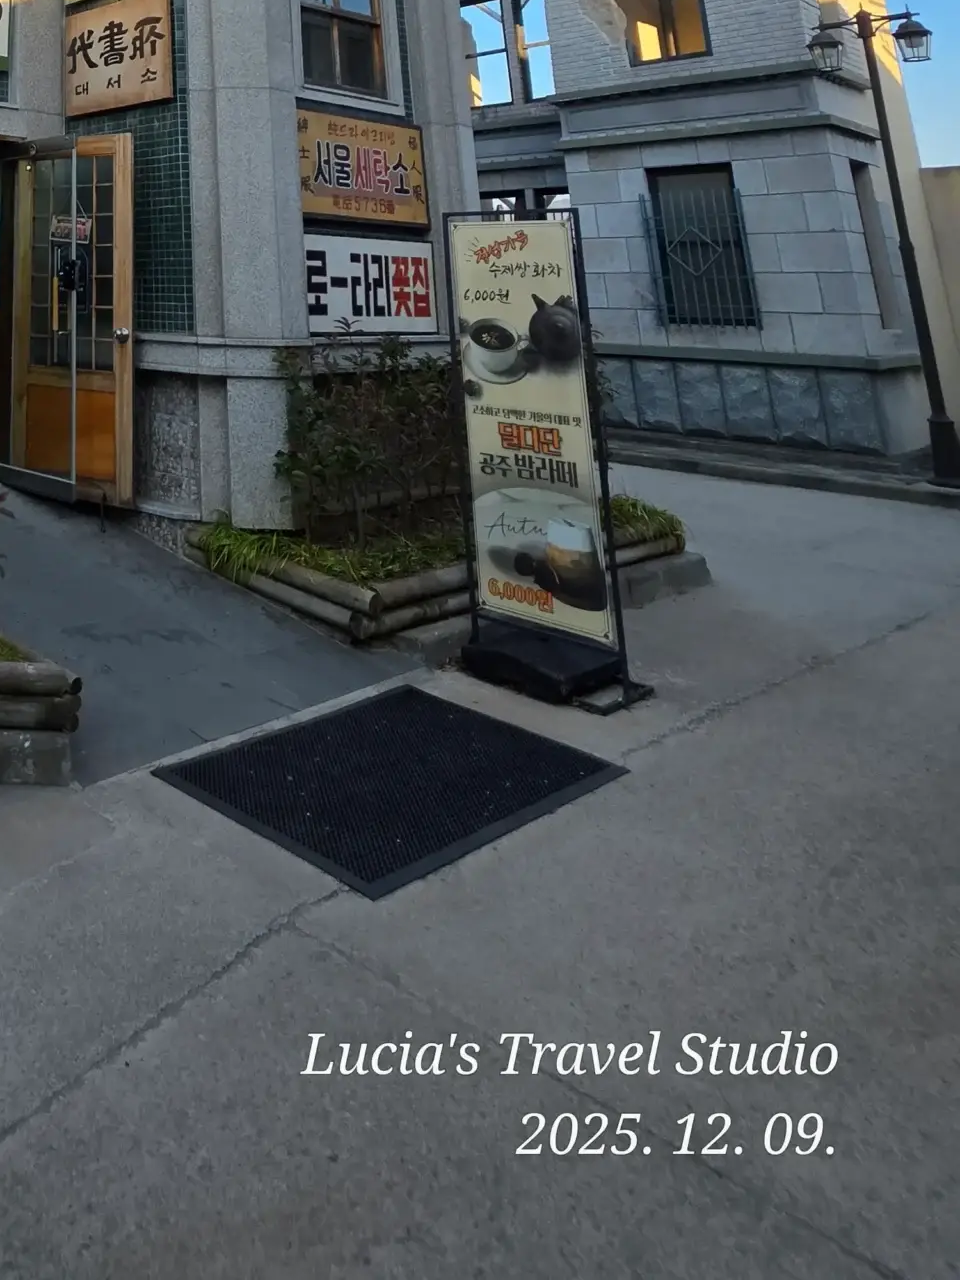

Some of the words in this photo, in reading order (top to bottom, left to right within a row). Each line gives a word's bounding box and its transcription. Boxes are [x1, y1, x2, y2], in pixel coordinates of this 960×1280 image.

[463, 288, 512, 305] 6,000원
[498, 421, 562, 457] 달디단
[487, 578, 554, 614] 6,000원
